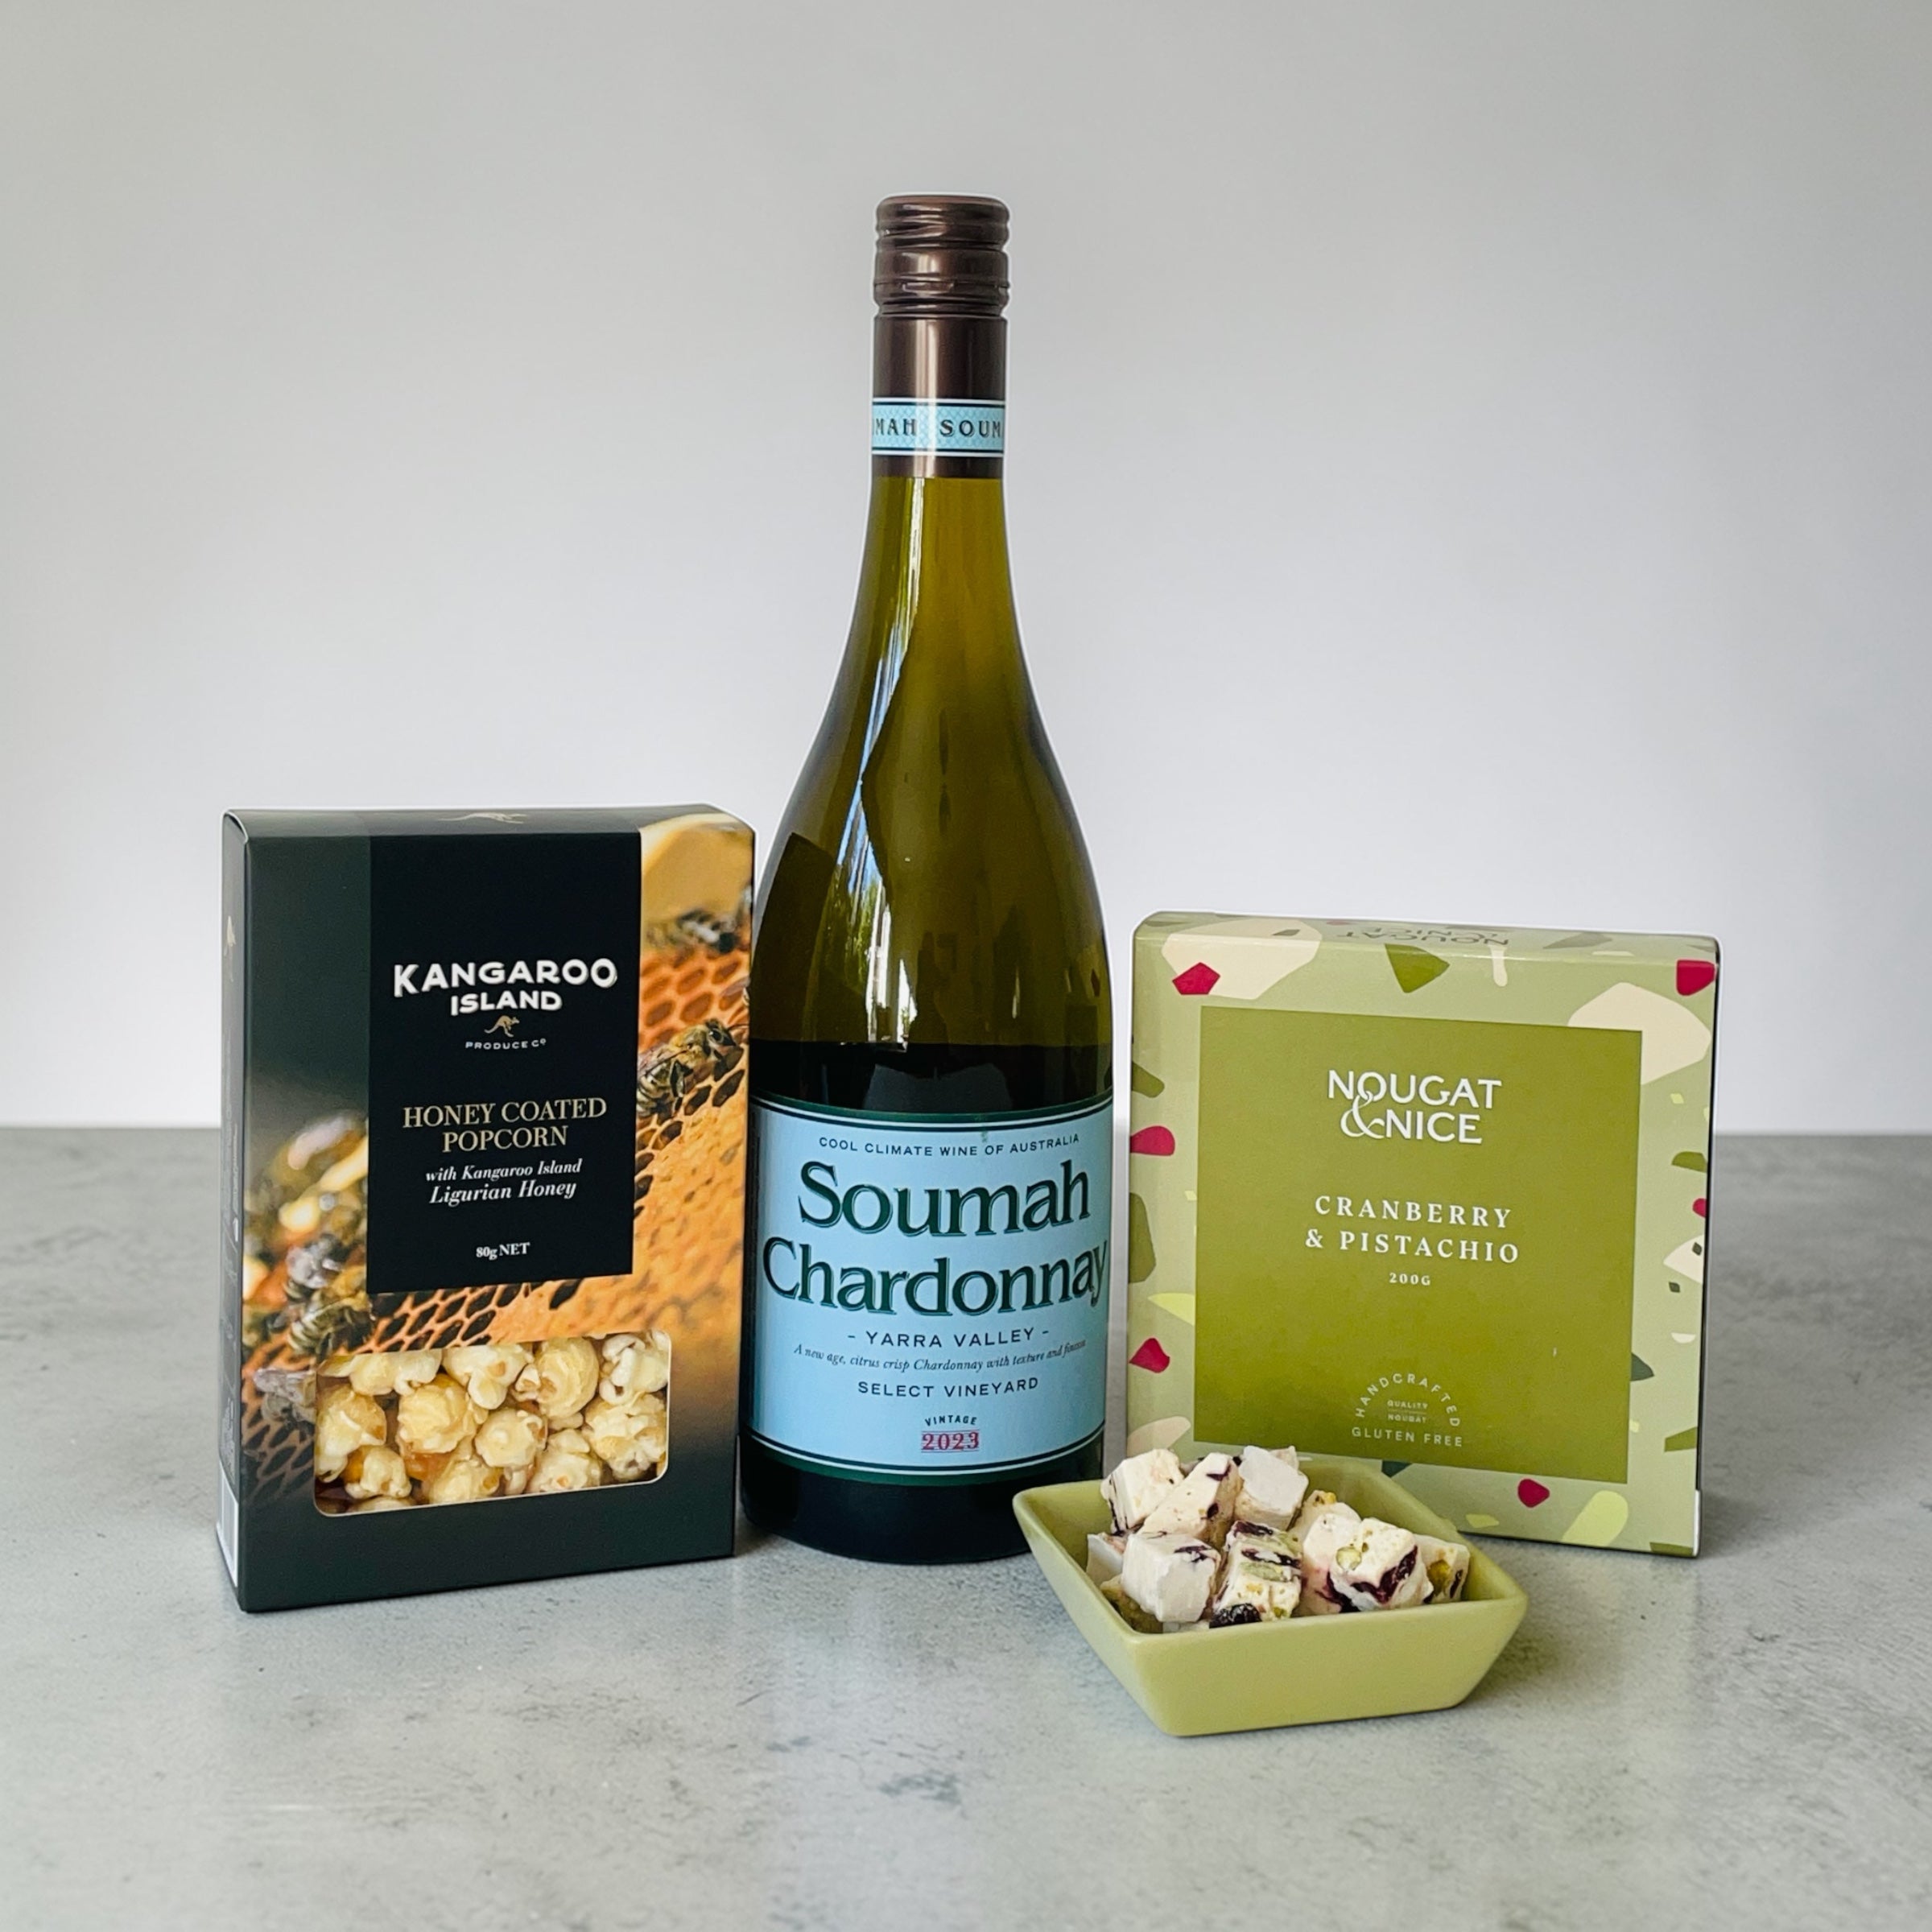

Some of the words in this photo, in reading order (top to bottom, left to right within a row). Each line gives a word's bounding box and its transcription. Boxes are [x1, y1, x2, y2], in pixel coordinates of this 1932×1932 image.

[873, 418, 917, 436] MAH
[939, 419, 1001, 438] SOUM
[394, 958, 617, 997] KANGAROO
[451, 990, 562, 1016] ISLAND
[465, 1041, 528, 1050] PRODUCE
[1327, 1070, 1503, 1108] NOUGAT
[402, 1103, 496, 1128] HONEY
[501, 1097, 607, 1123] COATED
[442, 1125, 568, 1153] POPCORN
[819, 1137, 858, 1151] COOL
[865, 1143, 932, 1156] CLIMATE
[939, 1146, 977, 1156] WINE
[985, 1145, 1004, 1155] OF
[1009, 1133, 1080, 1154] AUSTRALIA
[425, 1166, 456, 1182] with
[461, 1165, 534, 1182] Kangaroo
[538, 1158, 584, 1175] Island
[429, 1184, 512, 1207] Ligurian
[518, 1179, 577, 1199] Honey
[799, 1159, 1091, 1236] Soumah
[1315, 1195, 1511, 1228] CRANBERRY
[499, 1242, 530, 1257] NET
[1305, 1228, 1323, 1249] &
[1340, 1230, 1519, 1264] PISTACHIO
[763, 1236, 1108, 1316] Chardonnay
[1389, 1272, 1430, 1286] 200G
[865, 1331, 942, 1348] YARRA
[954, 1327, 1034, 1347] VALLEY
[794, 1344, 803, 1355] A
[805, 1348, 824, 1359] new
[827, 1352, 846, 1366] age,
[850, 1356, 880, 1368] citrus
[883, 1358, 910, 1373] crisp
[914, 1359, 983, 1373] Chardonnay
[986, 1356, 1009, 1368] with
[1013, 1352, 1045, 1364] texture
[858, 1381, 934, 1397] SELECT
[944, 1377, 1038, 1397] VINEYARD
[1355, 1373, 1460, 1426] HANDCRAFTED
[1387, 1400, 1428, 1409] QUALITY
[925, 1414, 977, 1426] VINTAGE
[922, 1431, 980, 1451] 2023
[1352, 1426, 1415, 1443] GLUTEN
[1423, 1433, 1463, 1447] FREE
